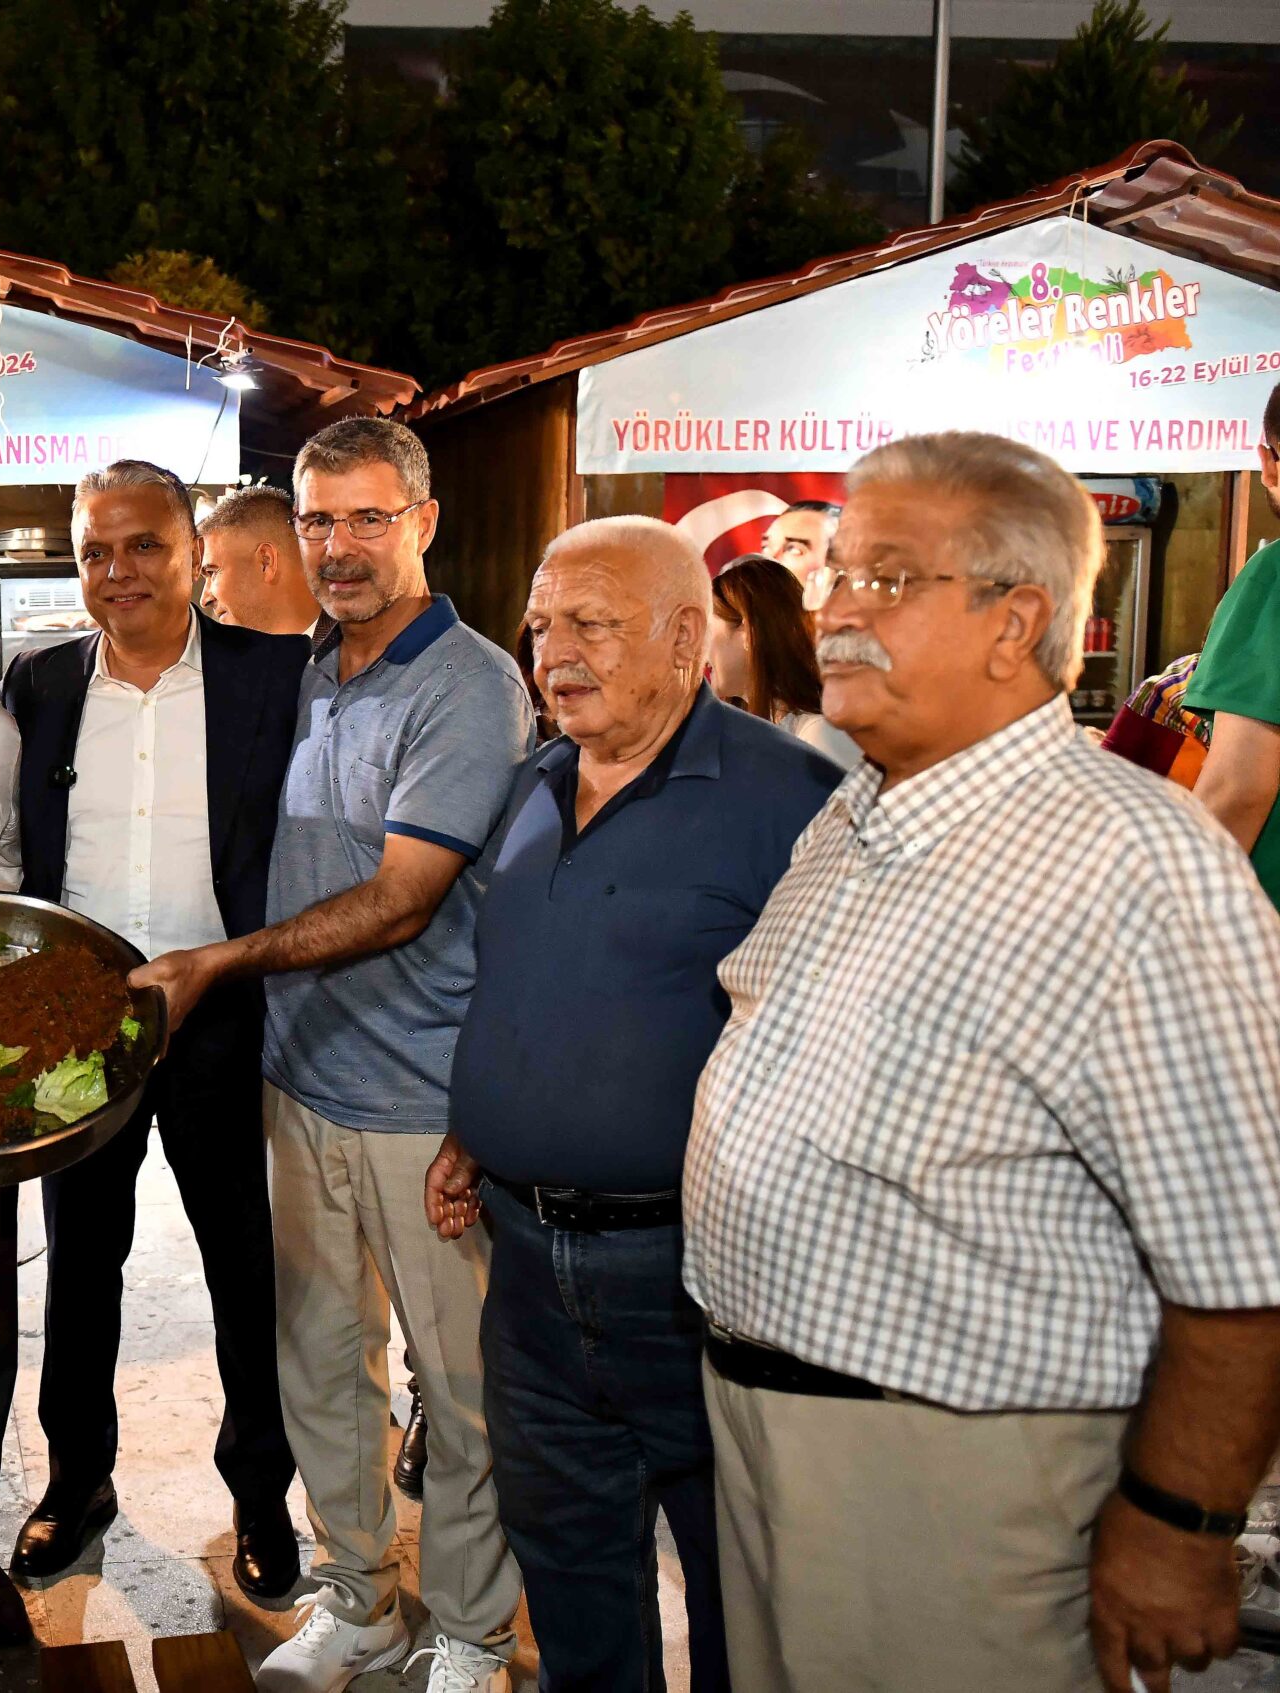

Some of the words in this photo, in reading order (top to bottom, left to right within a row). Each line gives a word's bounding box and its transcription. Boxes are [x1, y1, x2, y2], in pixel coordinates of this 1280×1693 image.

[1031, 262, 1062, 300] 8.
[927, 297, 1057, 352] Yöreler
[1064, 278, 1201, 333] Renkler
[1130, 365, 1187, 389] 16-22
[1194, 354, 1249, 384] Eylül
[613, 411, 771, 452] YÖRÜKLER
[780, 411, 894, 451] KÜLTÜR
[1088, 420, 1120, 451] VE
